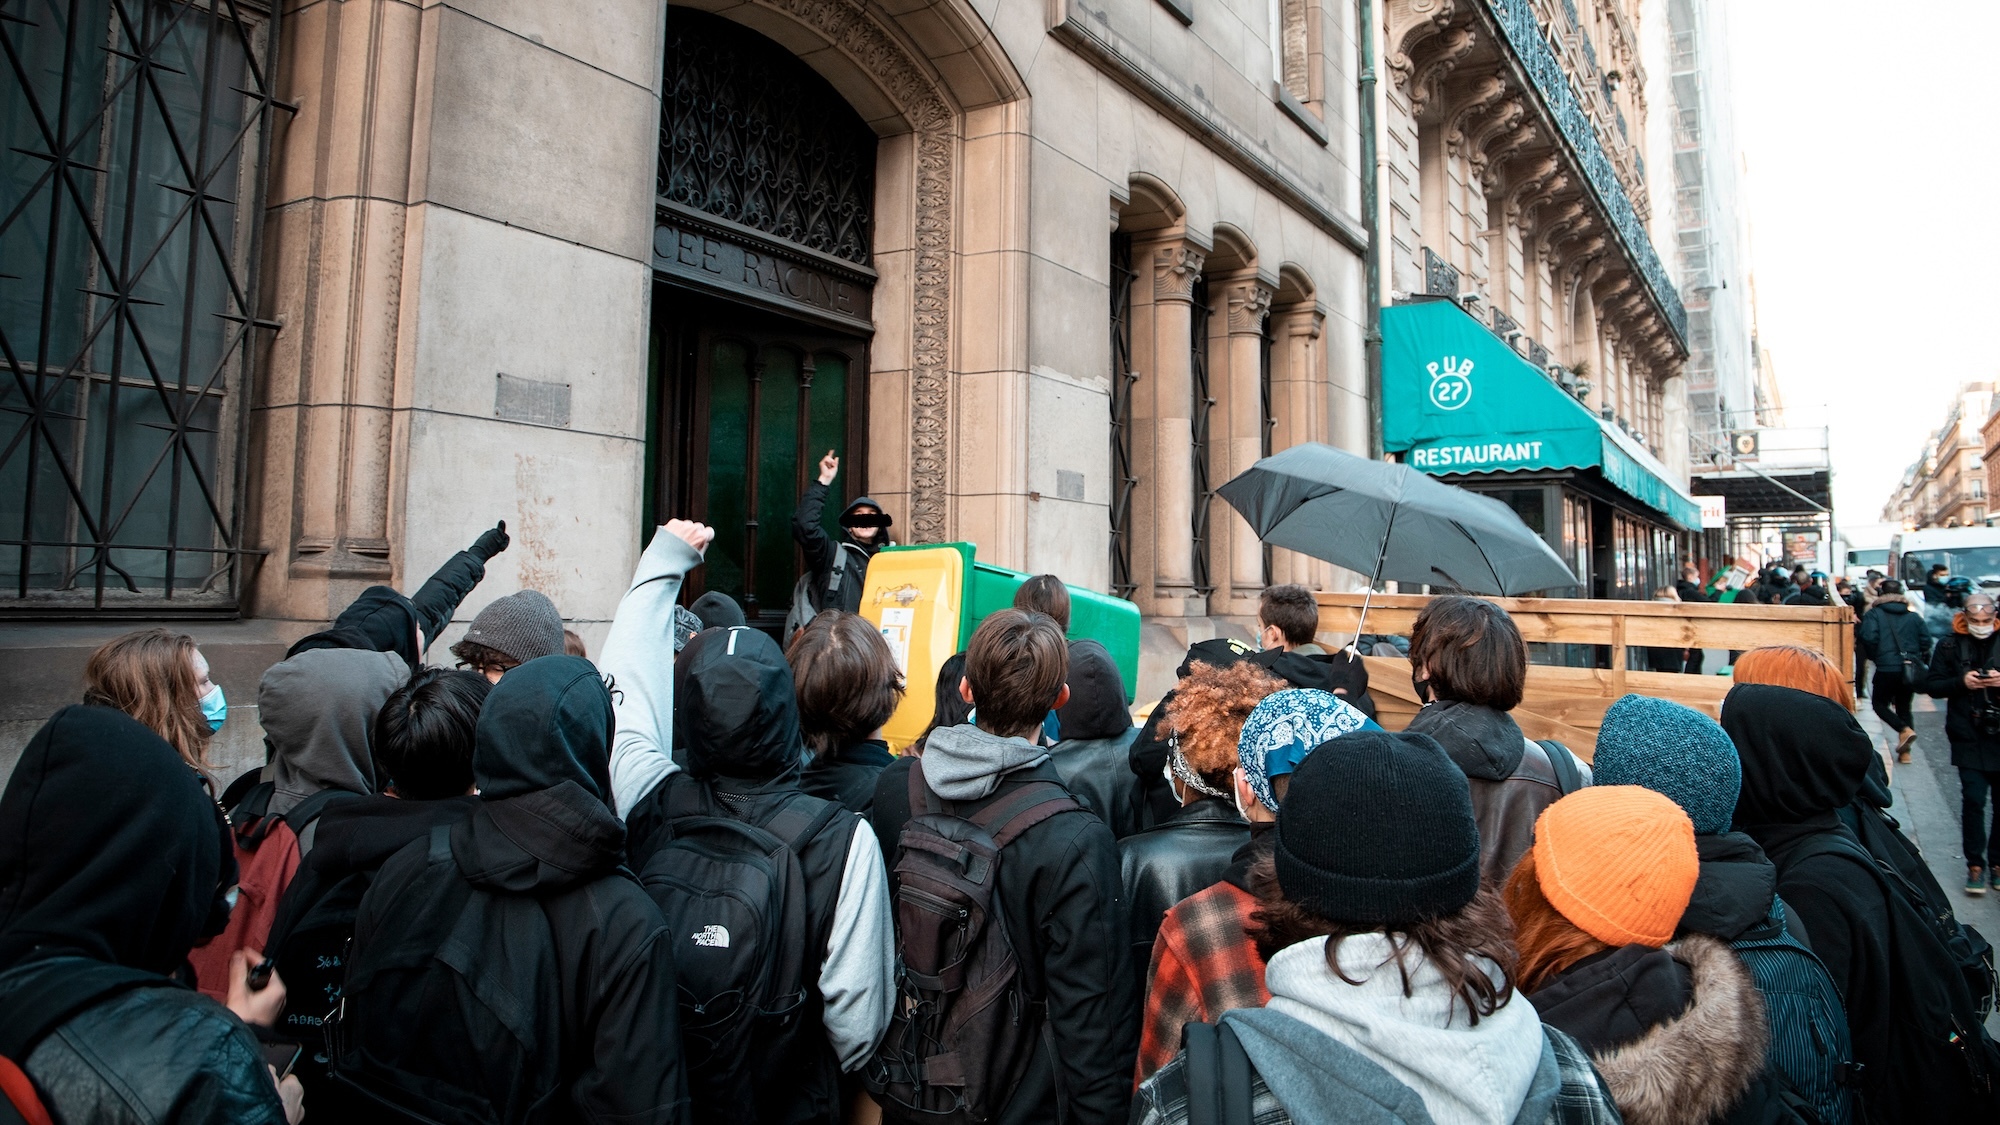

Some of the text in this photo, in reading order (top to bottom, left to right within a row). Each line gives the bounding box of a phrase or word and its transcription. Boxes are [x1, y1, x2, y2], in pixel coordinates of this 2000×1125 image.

[742, 250, 855, 316] RACINE
[1426, 355, 1475, 379] PUB
[1438, 381, 1464, 401] 27
[1413, 441, 1543, 467] RESTAURANT
[1700, 506, 1720, 517] rit
[691, 932, 716, 940] NORTH
[703, 925, 718, 933] THE
